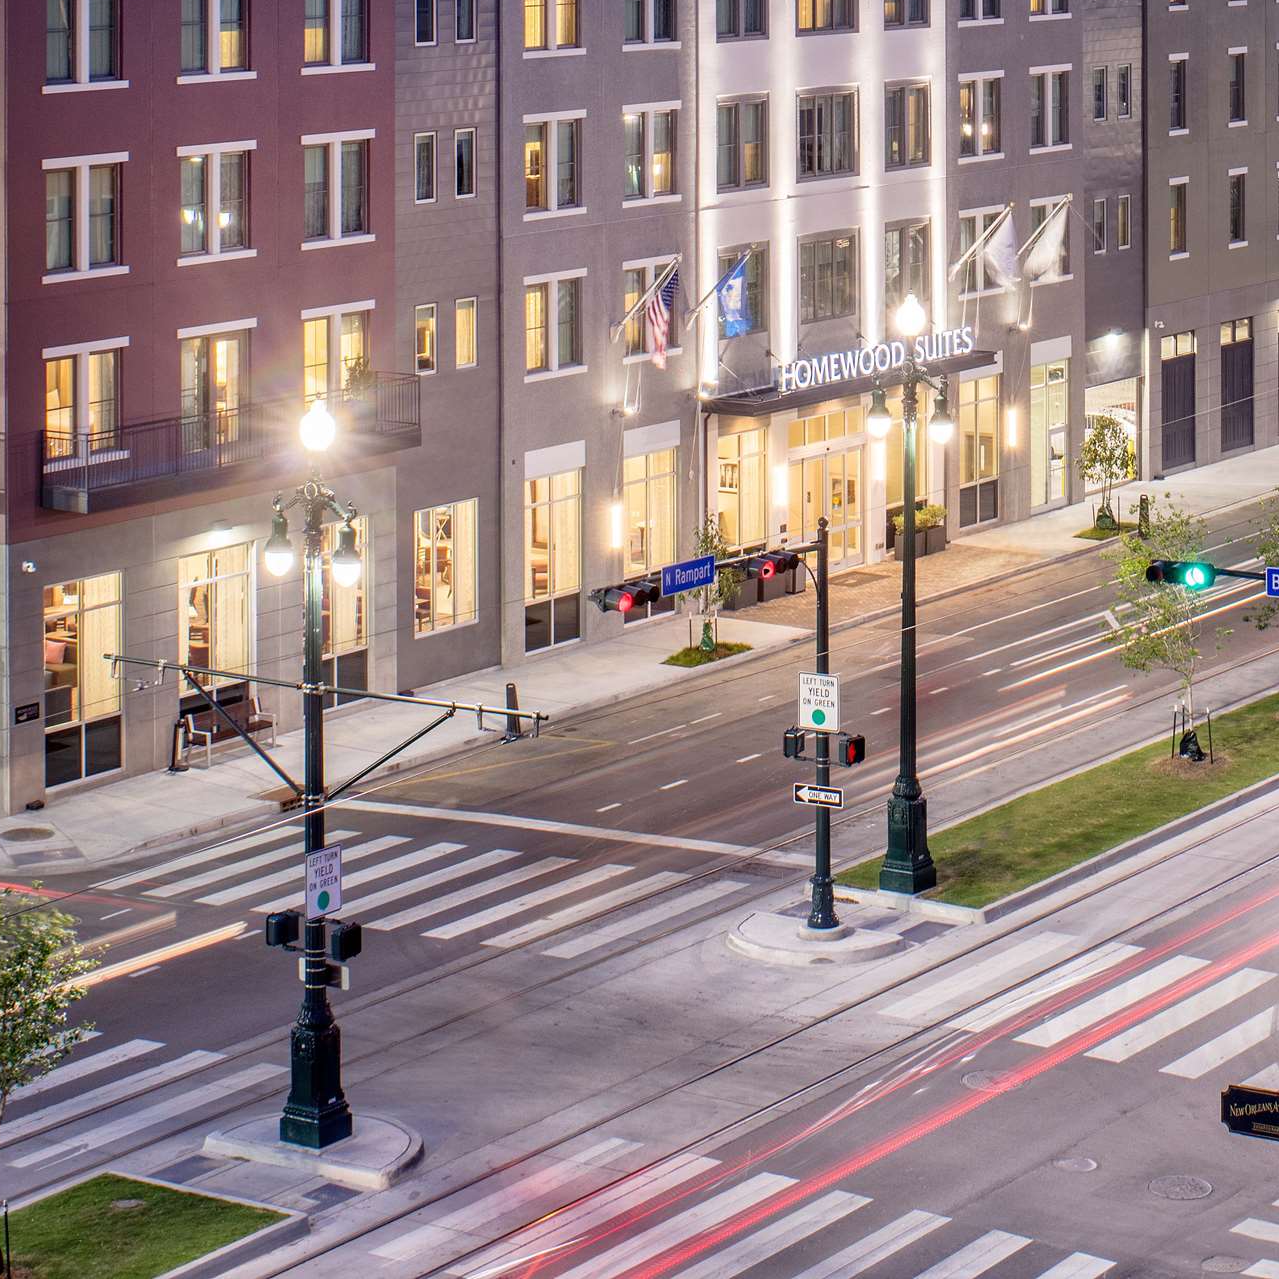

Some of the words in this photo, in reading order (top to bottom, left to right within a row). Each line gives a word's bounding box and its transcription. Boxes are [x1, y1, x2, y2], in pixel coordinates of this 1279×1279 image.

[780, 340, 905, 393] HOMEWOOD
[914, 326, 973, 363] SUITES
[665, 572, 671, 586] N
[675, 563, 711, 585] Rampart
[802, 677, 817, 686] LEFT
[819, 678, 835, 687] TURN
[808, 688, 830, 698] YIELD
[814, 699, 835, 708] GREEN
[808, 791, 822, 799] ONE
[824, 792, 838, 801] WAY
[309, 856, 322, 867] LEFT
[324, 851, 338, 861] TURN
[314, 863, 334, 878] YIELD
[320, 877, 338, 888] GREEN
